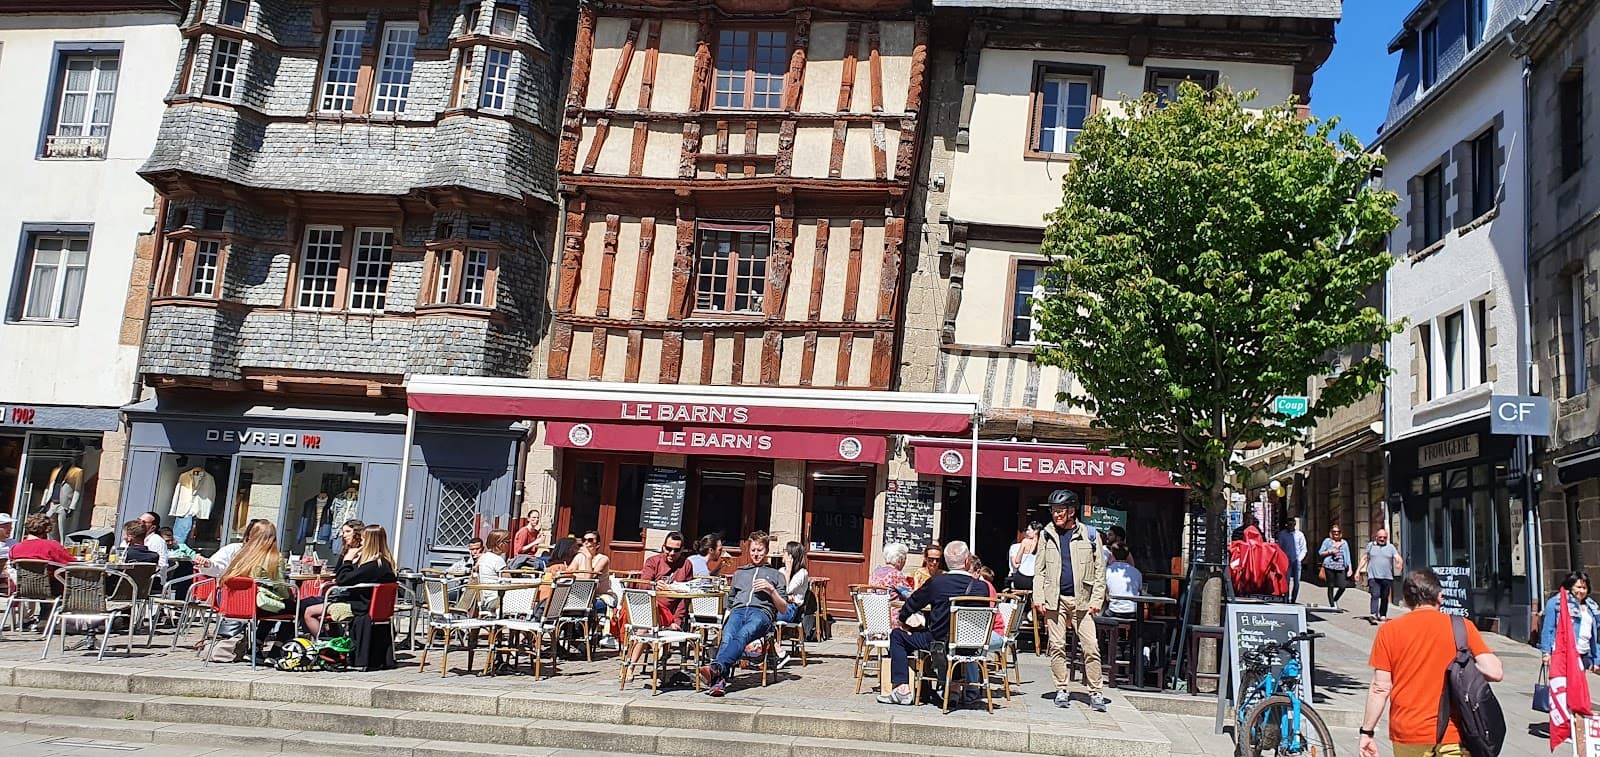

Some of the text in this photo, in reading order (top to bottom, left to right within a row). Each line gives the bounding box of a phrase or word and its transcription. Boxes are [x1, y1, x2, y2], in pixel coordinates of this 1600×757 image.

[620, 403, 749, 423] LE BARN'S
[1279, 400, 1304, 411] Coup
[12, 407, 36, 424] 1902
[206, 430, 321, 449] DEVRED 1902
[658, 431, 772, 450] LE BARN'S
[1424, 437, 1471, 461] FROMAGERIE
[1003, 457, 1125, 477] LE BARN'S
